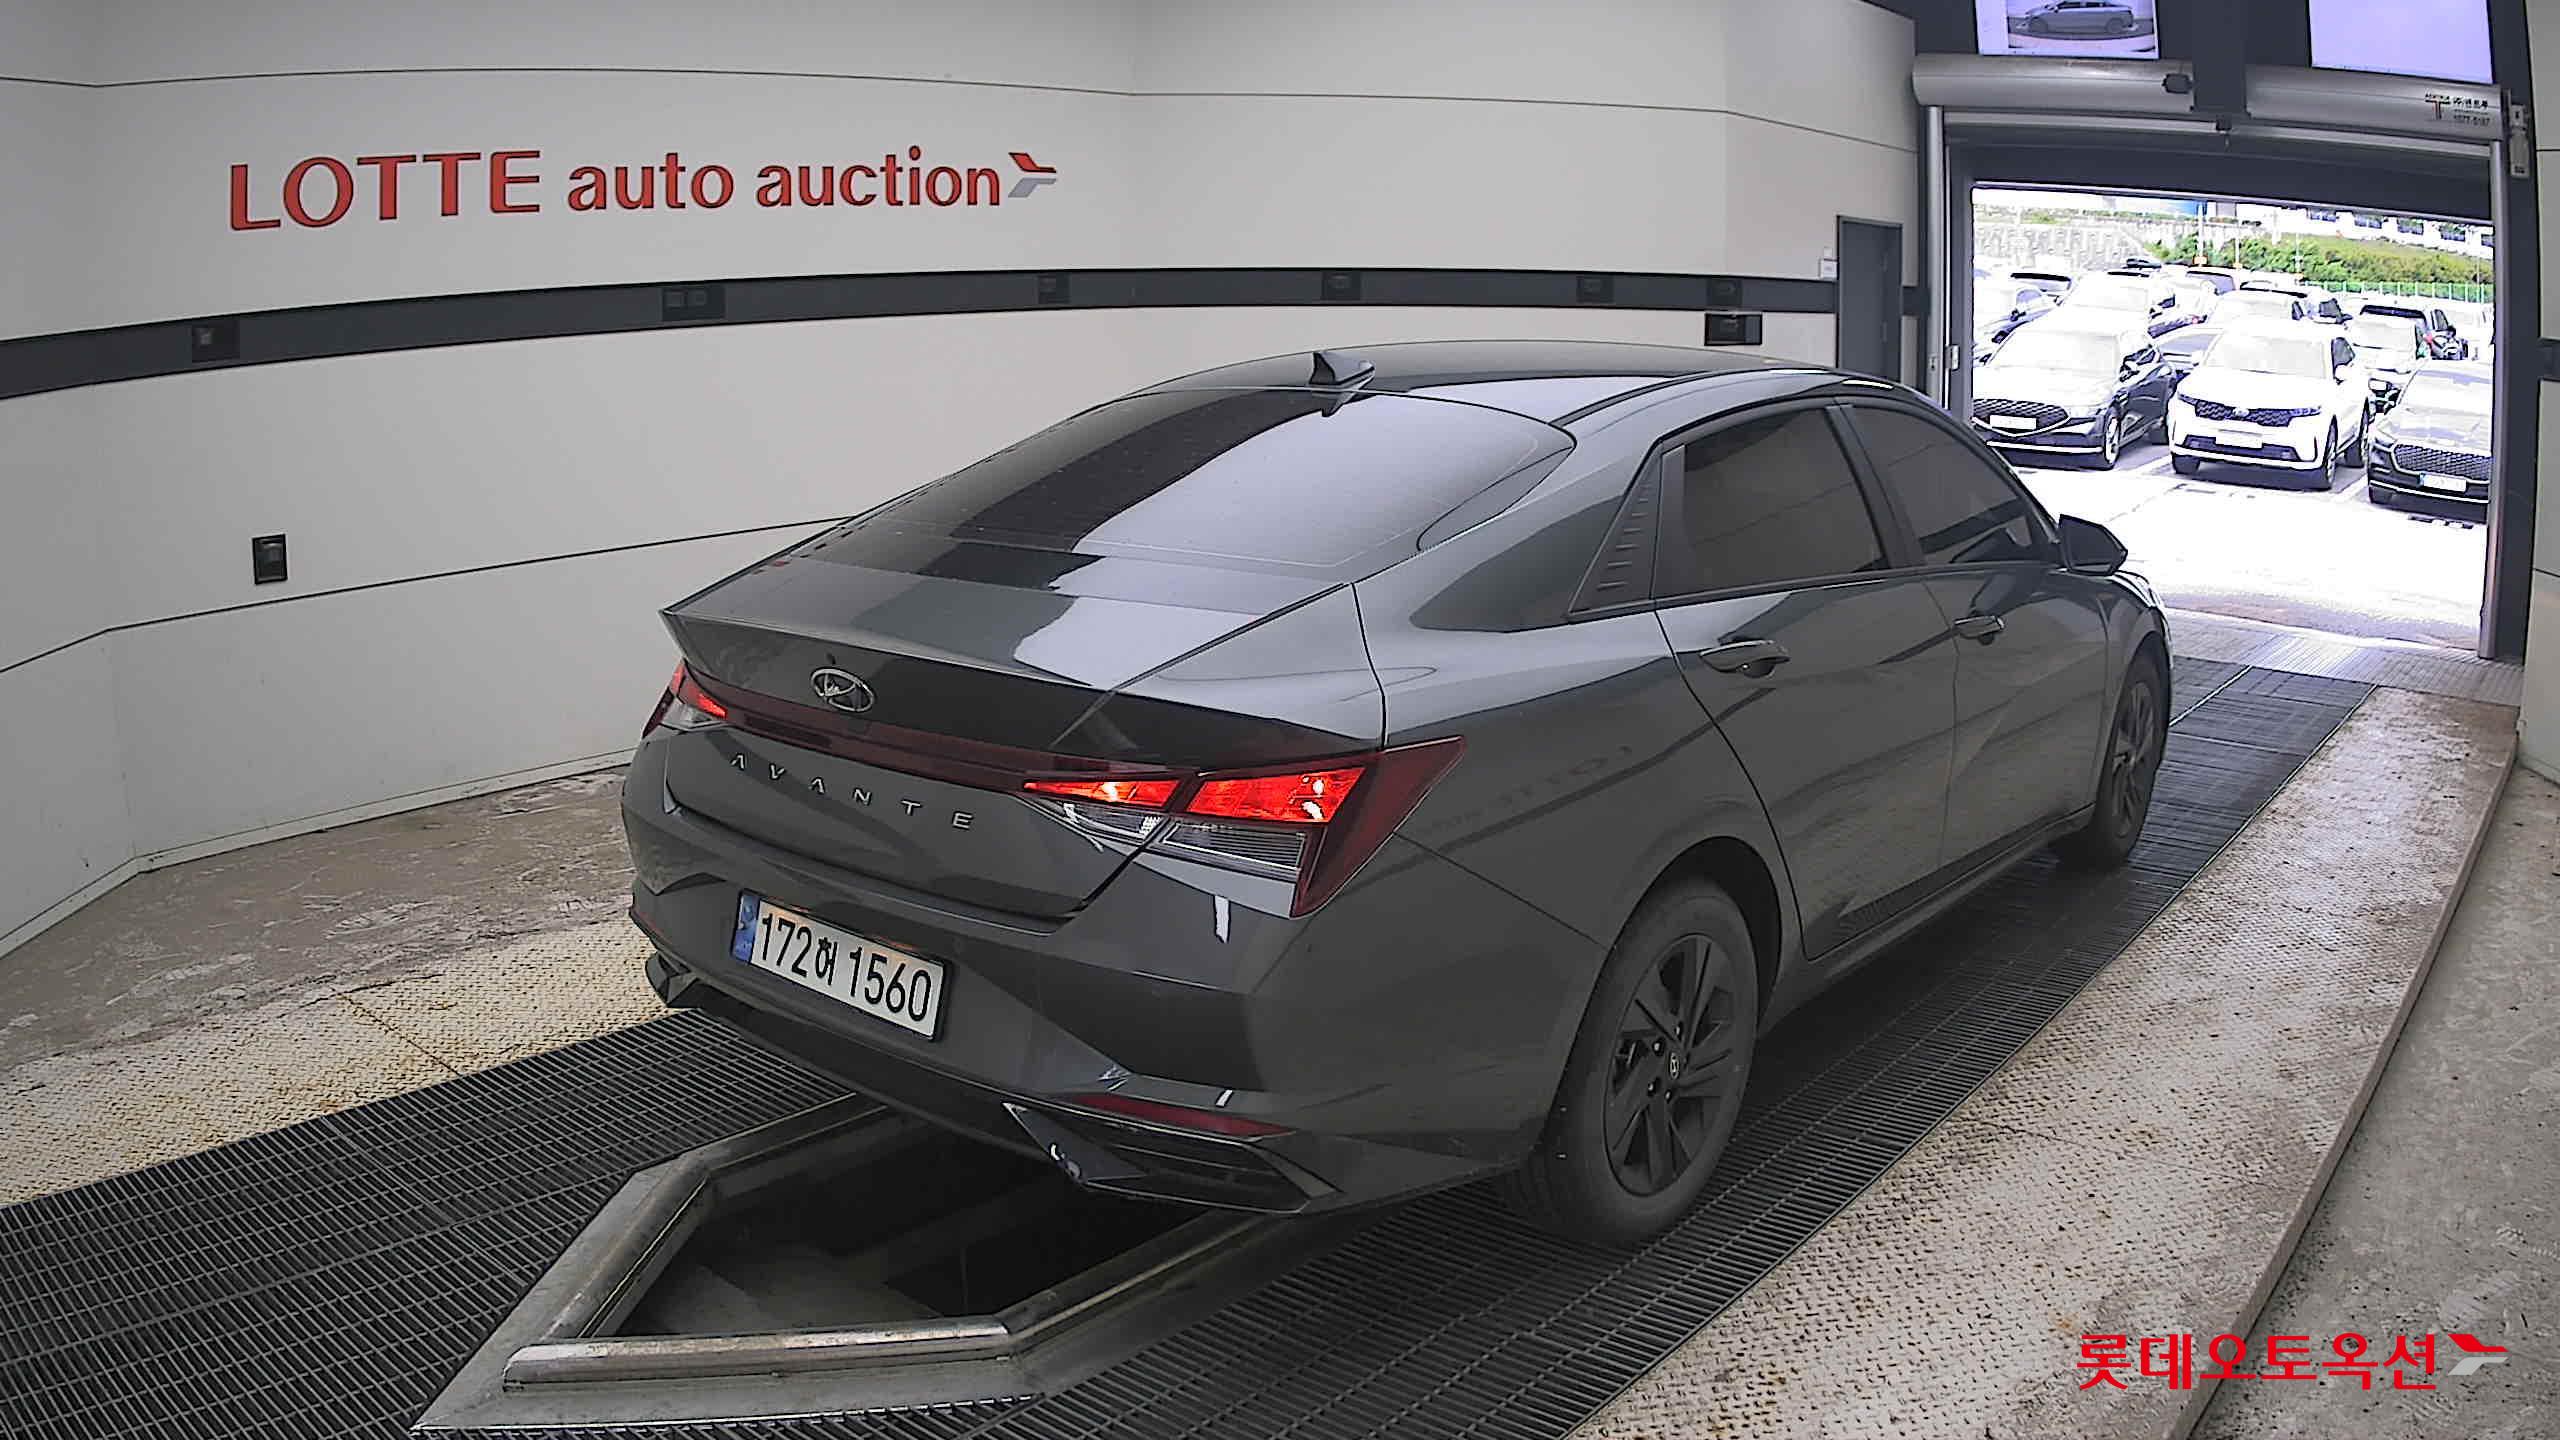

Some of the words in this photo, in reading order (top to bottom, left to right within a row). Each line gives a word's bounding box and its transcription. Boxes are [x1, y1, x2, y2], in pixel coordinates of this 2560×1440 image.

[231, 151, 540, 231] LOTTE
[567, 153, 735, 210] auto
[757, 147, 1001, 208] auction
[731, 753, 975, 829] AVANTE
[762, 912, 838, 986] 172허
[849, 946, 932, 1022] 1560
